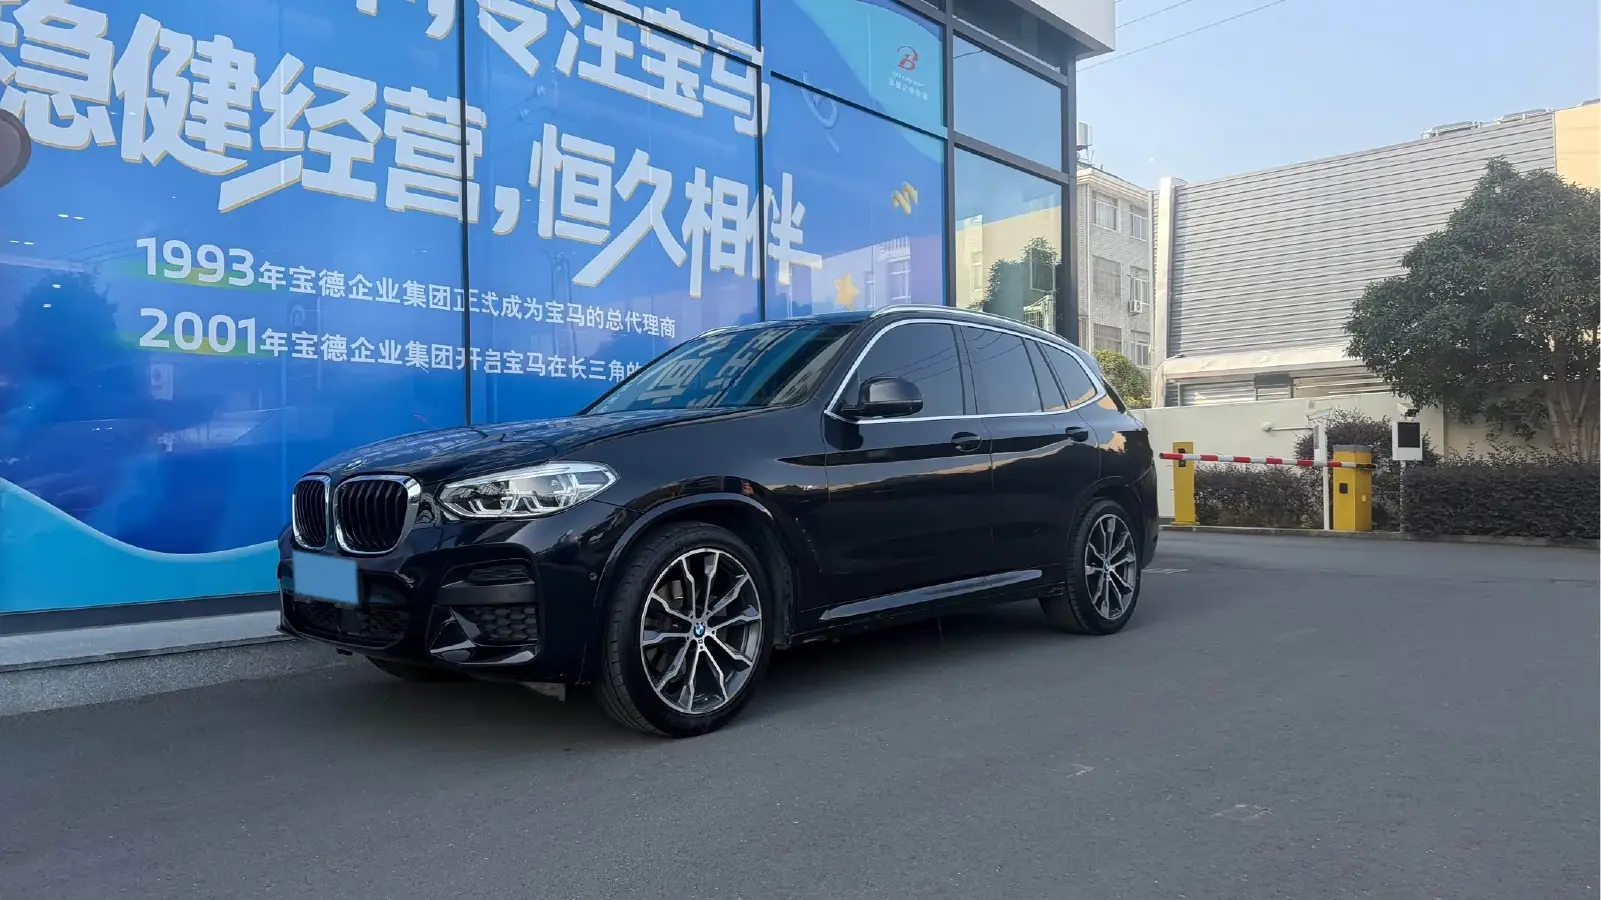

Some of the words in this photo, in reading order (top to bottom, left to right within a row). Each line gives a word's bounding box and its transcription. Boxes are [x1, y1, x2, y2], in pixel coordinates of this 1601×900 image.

[357, 0, 770, 137] ，专注宝马
[136, 237, 676, 338] 1993年宝德企业集团正式成为宝马的总代理商
